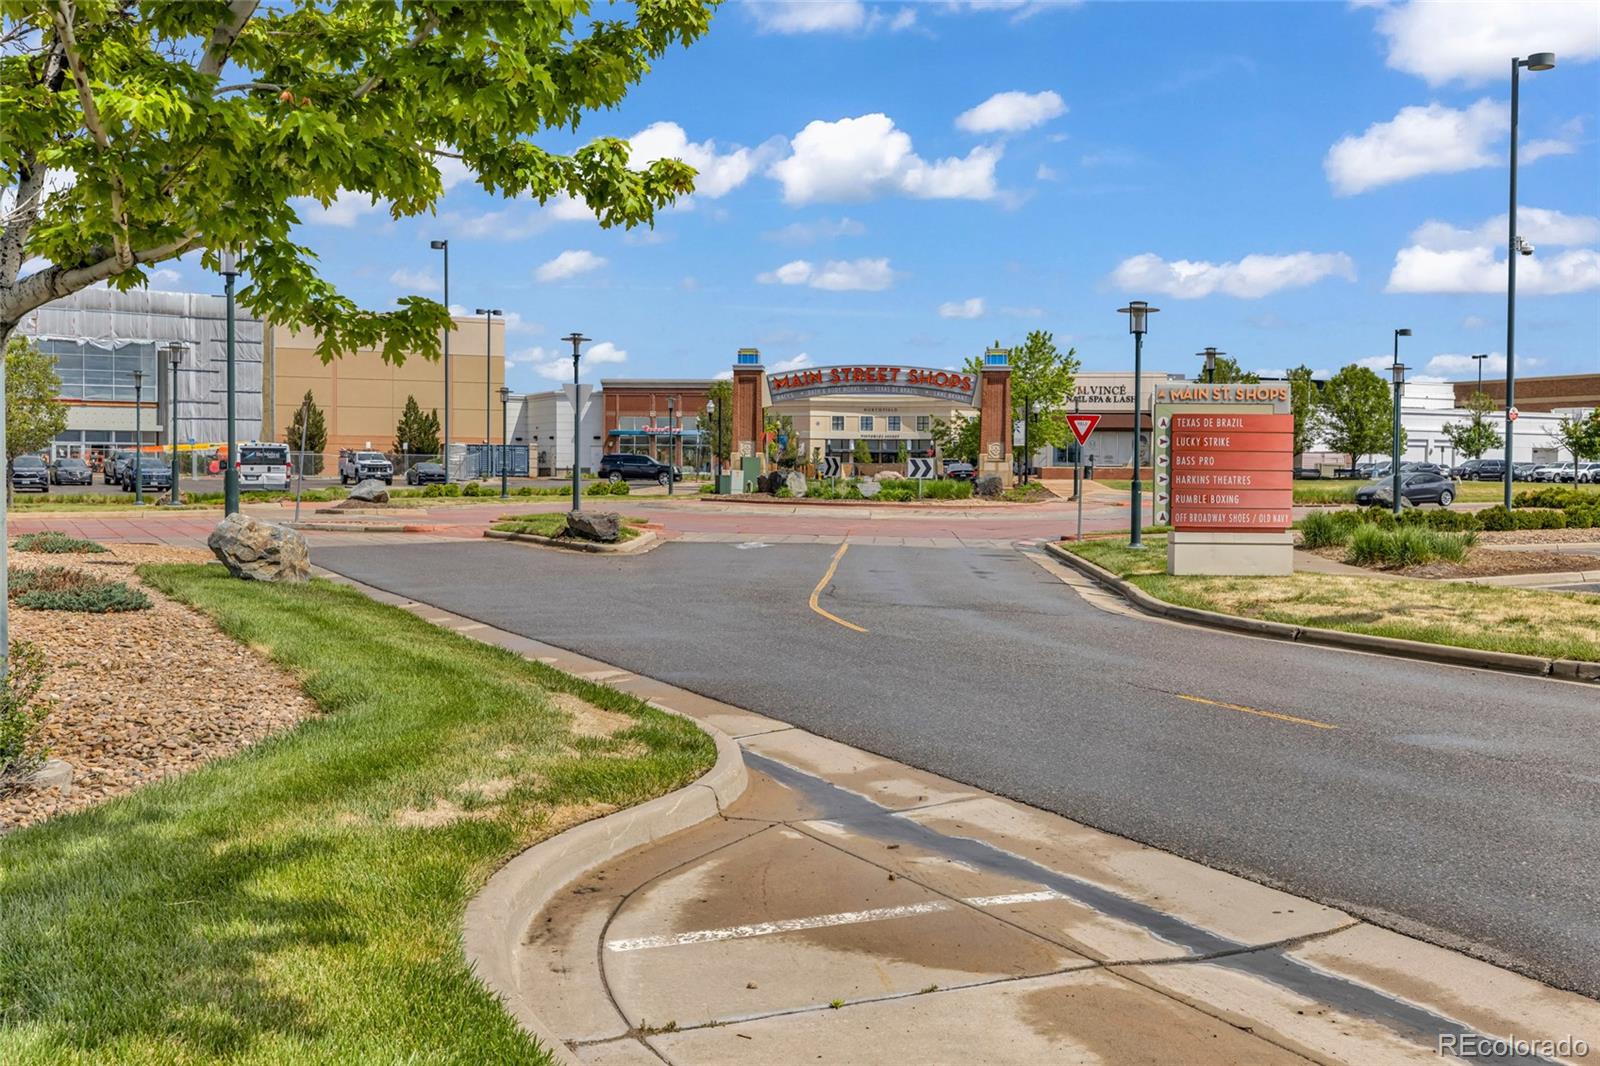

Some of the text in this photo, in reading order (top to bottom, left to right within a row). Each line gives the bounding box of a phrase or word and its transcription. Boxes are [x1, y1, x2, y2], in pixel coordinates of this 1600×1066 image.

[772, 368, 971, 391] MAIN STREET SHOPS
[1090, 384, 1126, 395] VINCÉ
[1170, 387, 1288, 401] MAIN ST. SHOPS
[1177, 418, 1243, 427] TEXAS DE BRAZIL
[1176, 437, 1230, 447] LUCKY STRIKE
[1176, 456, 1215, 465] BASS PRO
[1175, 475, 1251, 485] HARKINS THEATRES
[1175, 494, 1240, 504] RUMBLE BOXING
[1175, 513, 1187, 523] OFF
[1189, 513, 1226, 523] BROADWAY
[1229, 513, 1250, 523] SHOES
[1259, 513, 1271, 523] OLD
[1273, 513, 1289, 523] NAVY
